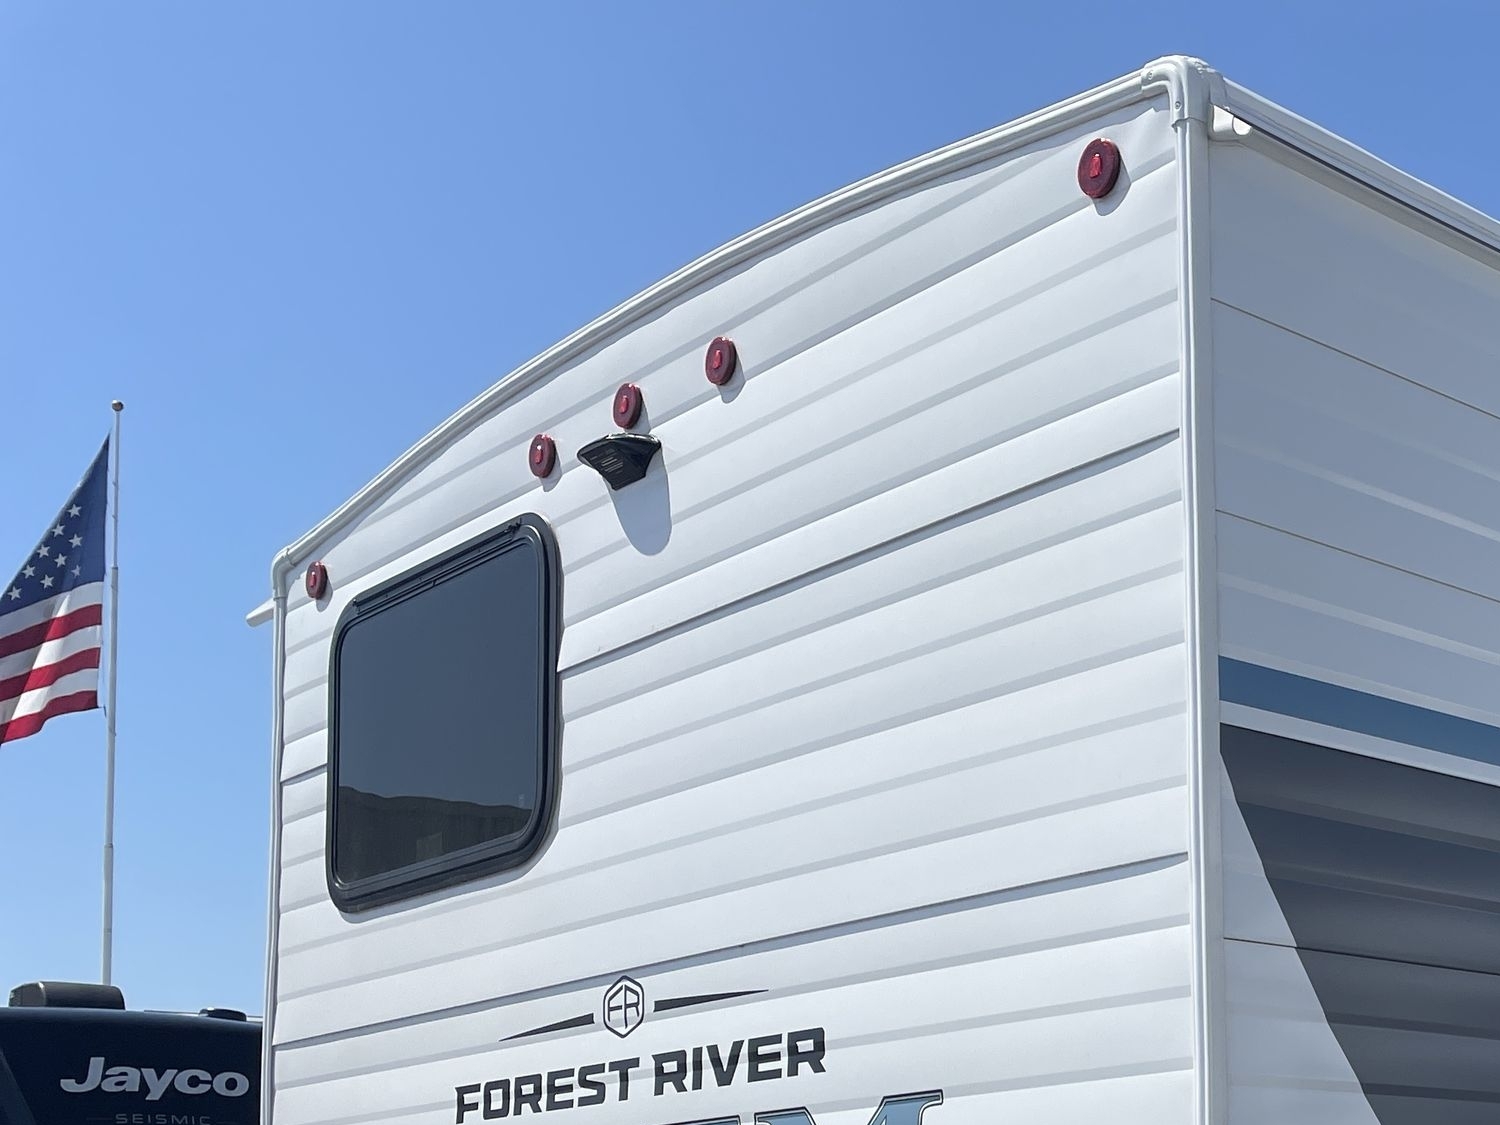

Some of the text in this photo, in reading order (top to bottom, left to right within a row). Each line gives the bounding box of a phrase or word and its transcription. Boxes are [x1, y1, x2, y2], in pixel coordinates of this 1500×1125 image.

[60, 1056, 250, 1101] Jayco
[454, 1026, 828, 1125] FOREST RIVER
